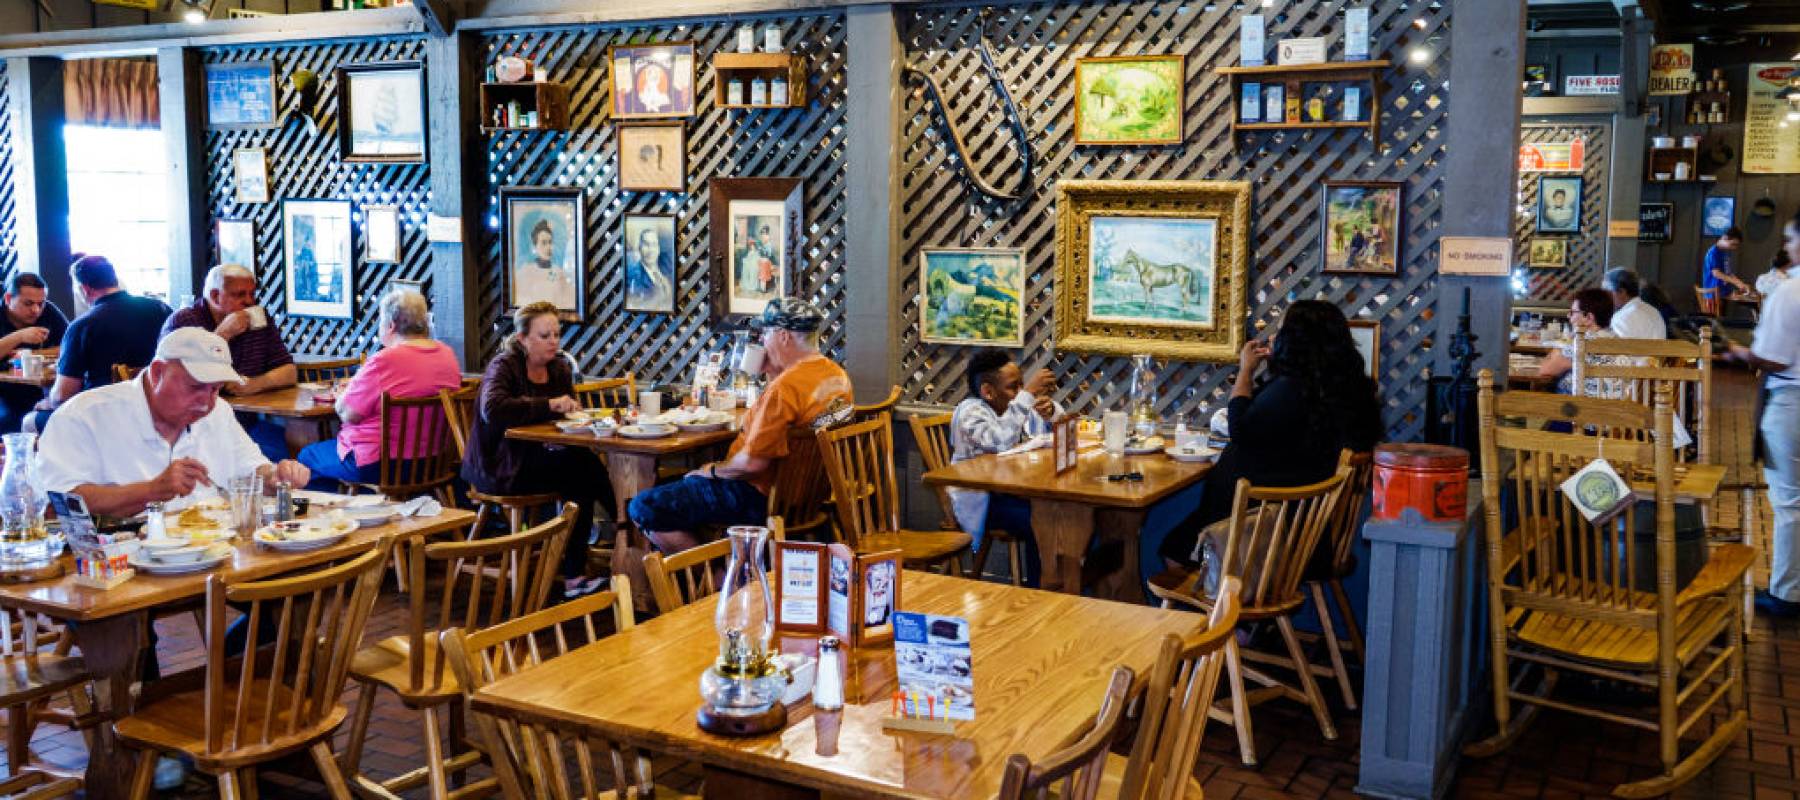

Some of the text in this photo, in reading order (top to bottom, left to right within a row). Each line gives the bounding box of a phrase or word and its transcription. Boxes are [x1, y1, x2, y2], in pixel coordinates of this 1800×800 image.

[1568, 77, 1592, 87] FIVE
[1651, 77, 1689, 91] DEALER
[1448, 251, 1502, 260] NO SMOKING
